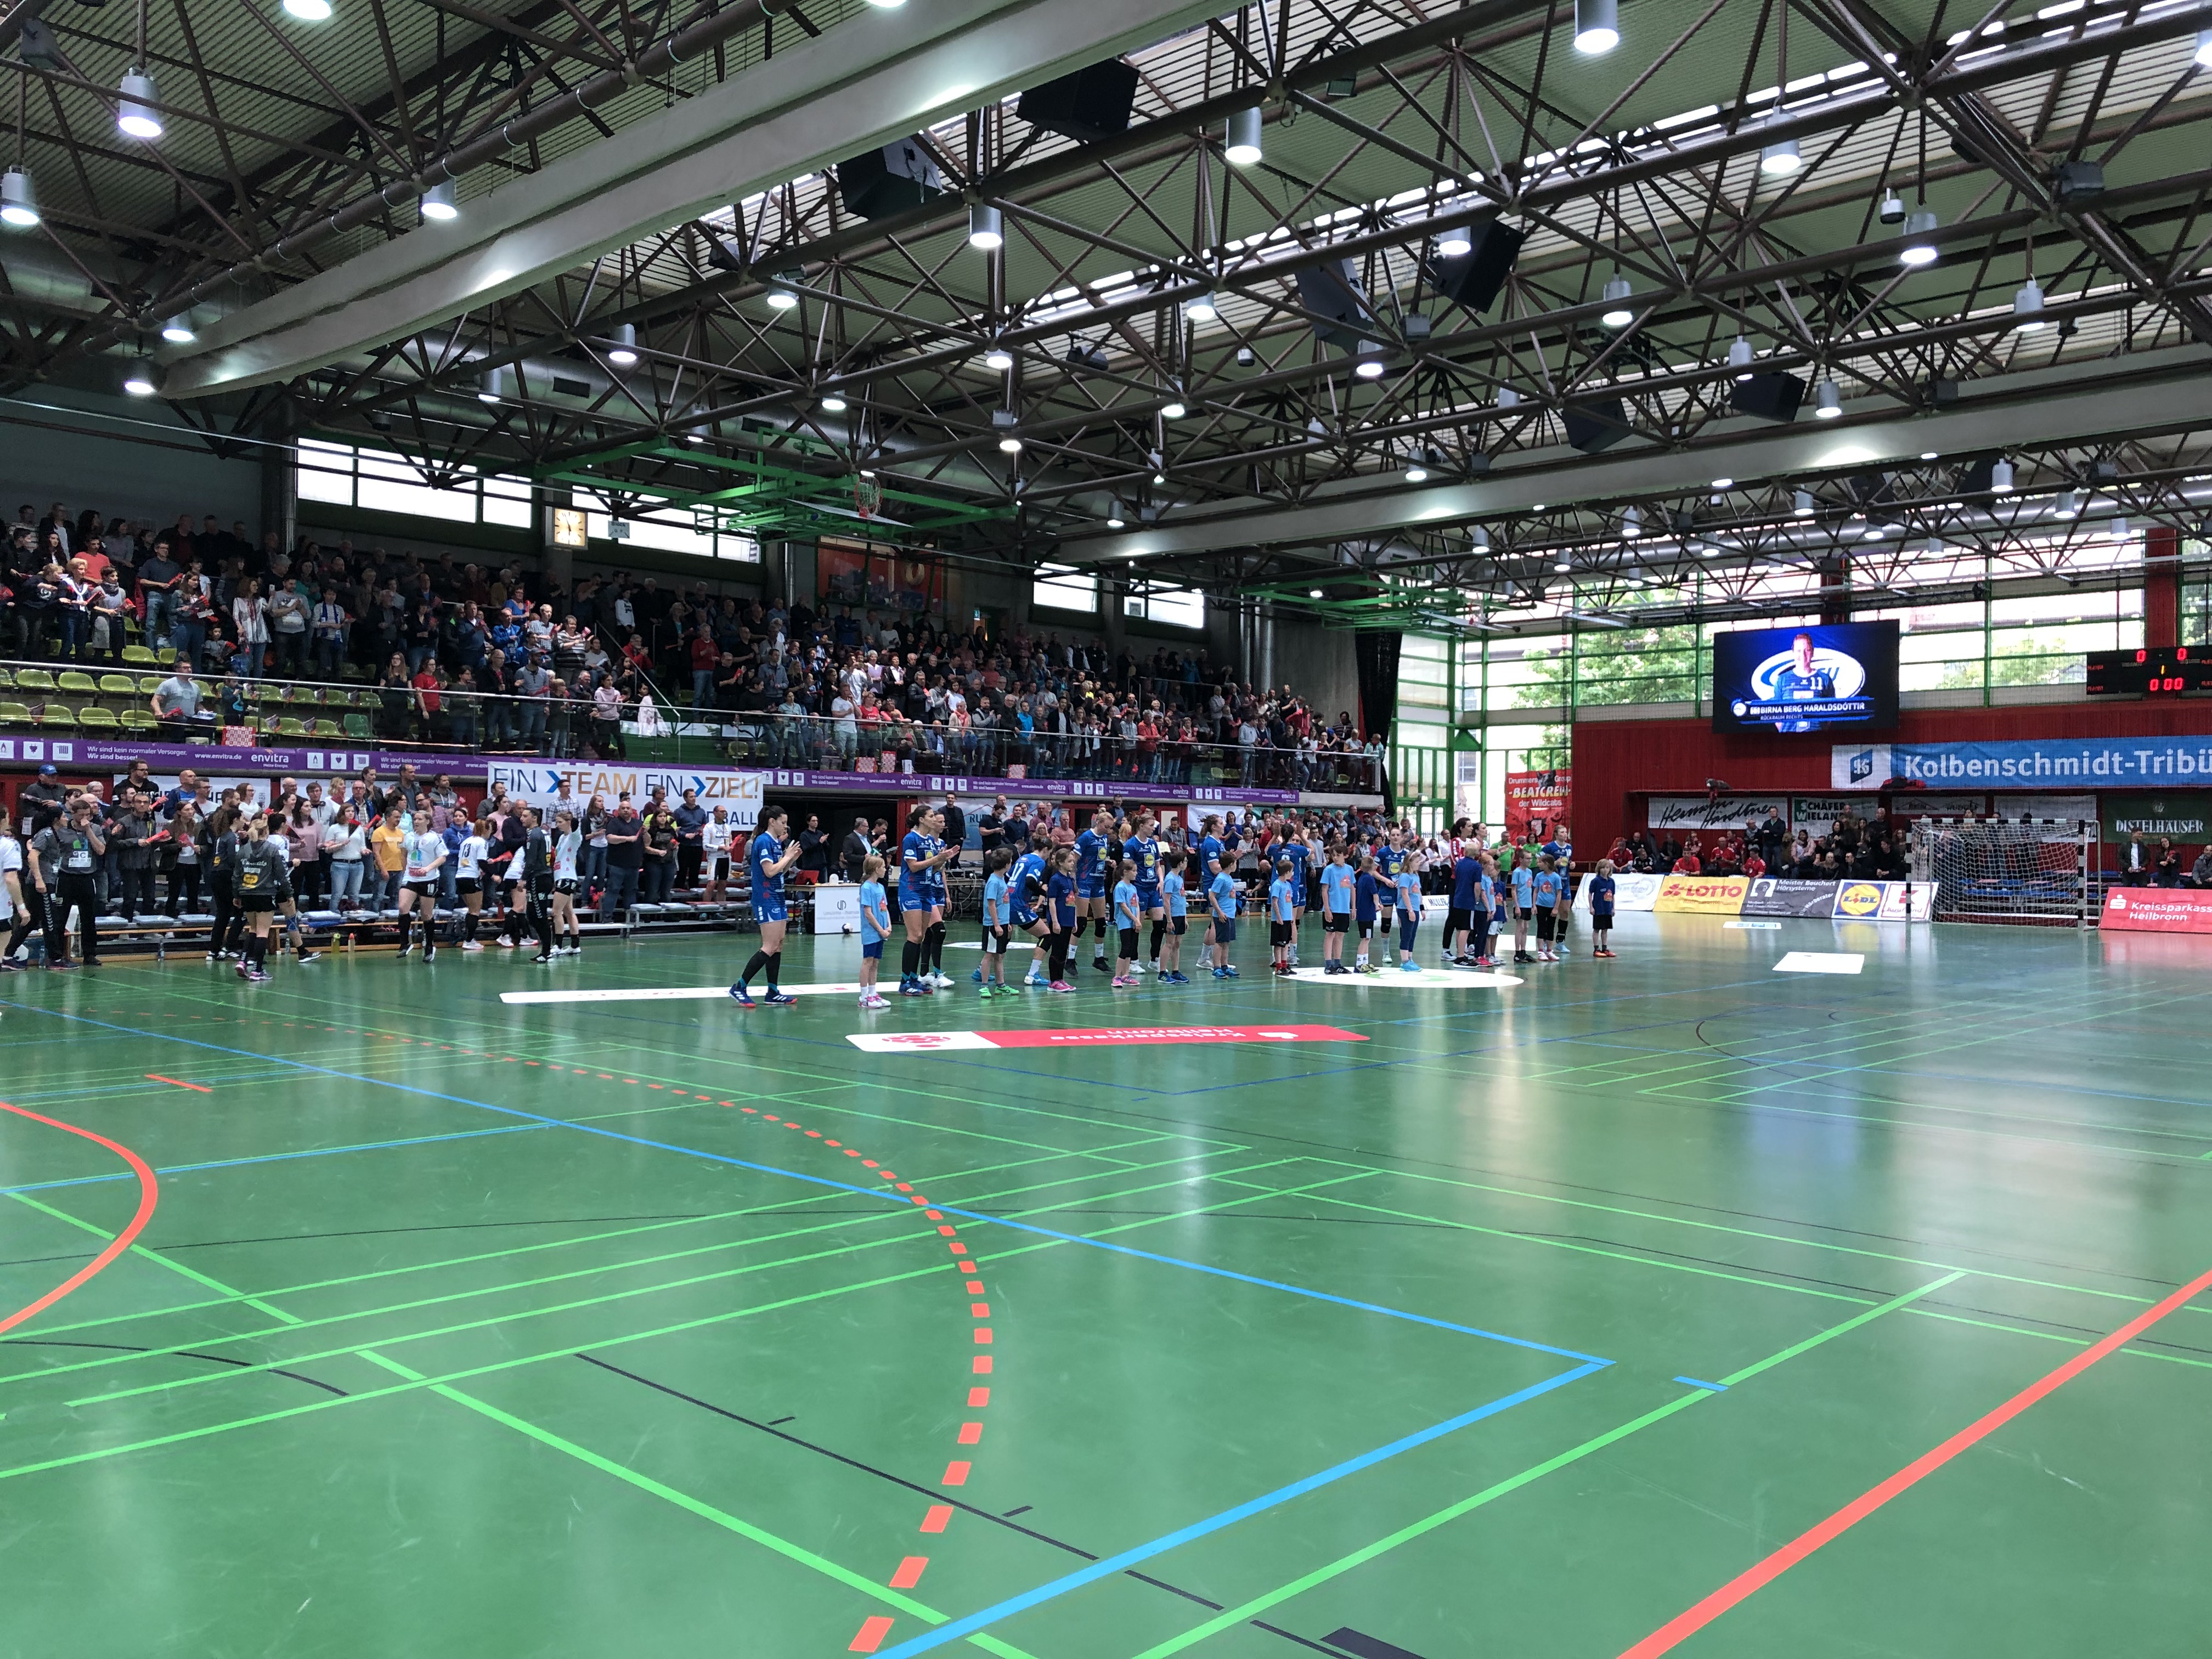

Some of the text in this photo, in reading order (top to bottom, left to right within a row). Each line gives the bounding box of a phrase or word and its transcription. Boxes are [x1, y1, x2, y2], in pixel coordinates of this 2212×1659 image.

[2136, 648, 2187, 663] 0 0
[1810, 677, 1822, 690] 11
[1804, 702, 1865, 712] HARALDSDÓTTIR
[251, 754, 289, 763] envitra
[1905, 749, 2212, 778] Kolbenschmidt-Tribü
[494, 768, 636, 795] EIN TEAM
[1554, 775, 1571, 783] Group
[646, 774, 759, 799] EIN ZIEL!
[462, 843, 471, 857] 13
[1686, 885, 1742, 898] LOTTO
[2129, 911, 2187, 921] Heilbronn
